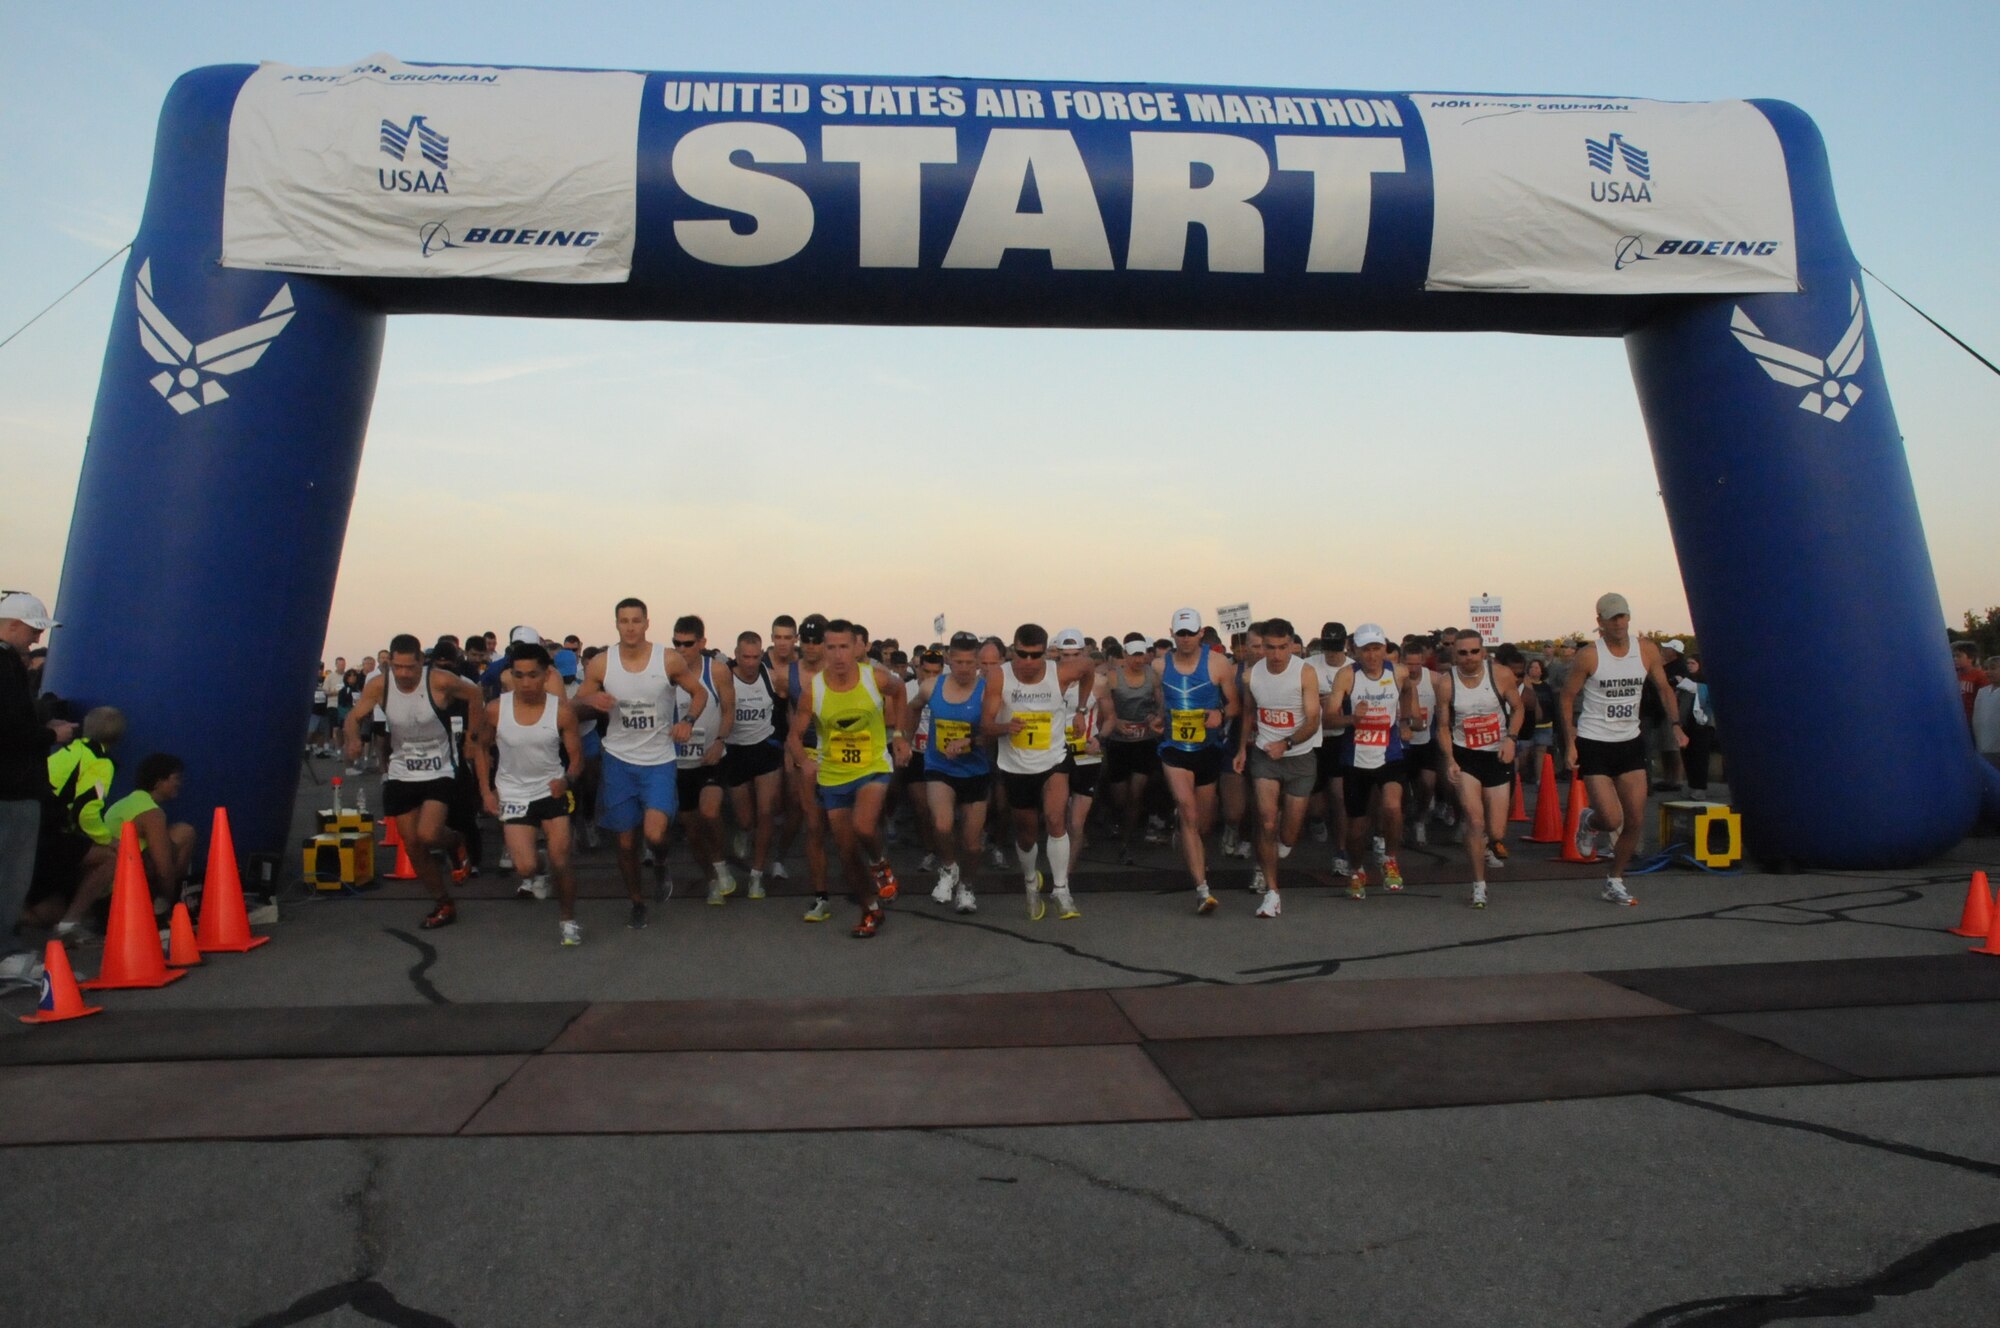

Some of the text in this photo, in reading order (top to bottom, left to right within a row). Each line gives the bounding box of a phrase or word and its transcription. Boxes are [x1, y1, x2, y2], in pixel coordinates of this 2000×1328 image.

[662, 81, 1404, 128] UNITED STATES AIR FORCE MARATHON
[1536, 103, 1629, 111] GRUMMAN
[379, 168, 449, 193] USAA
[671, 121, 1406, 273] START
[1590, 181, 1652, 203] USAA
[463, 227, 600, 248] BOEING
[1654, 239, 1778, 257] BOEING
[1226, 621, 1247, 631] 7:15
[1600, 678, 1643, 688] NATIONAL
[1011, 691, 1052, 699] MARATHON
[1606, 689, 1636, 698] GUARD
[736, 708, 766, 721] 8024
[1264, 709, 1289, 724] 356
[622, 715, 655, 729] 8481
[1027, 732, 1034, 745] 1
[1354, 729, 1387, 743] 2371
[1467, 730, 1498, 745] 1151
[842, 749, 861, 763] 38
[406, 756, 442, 771] 8220
